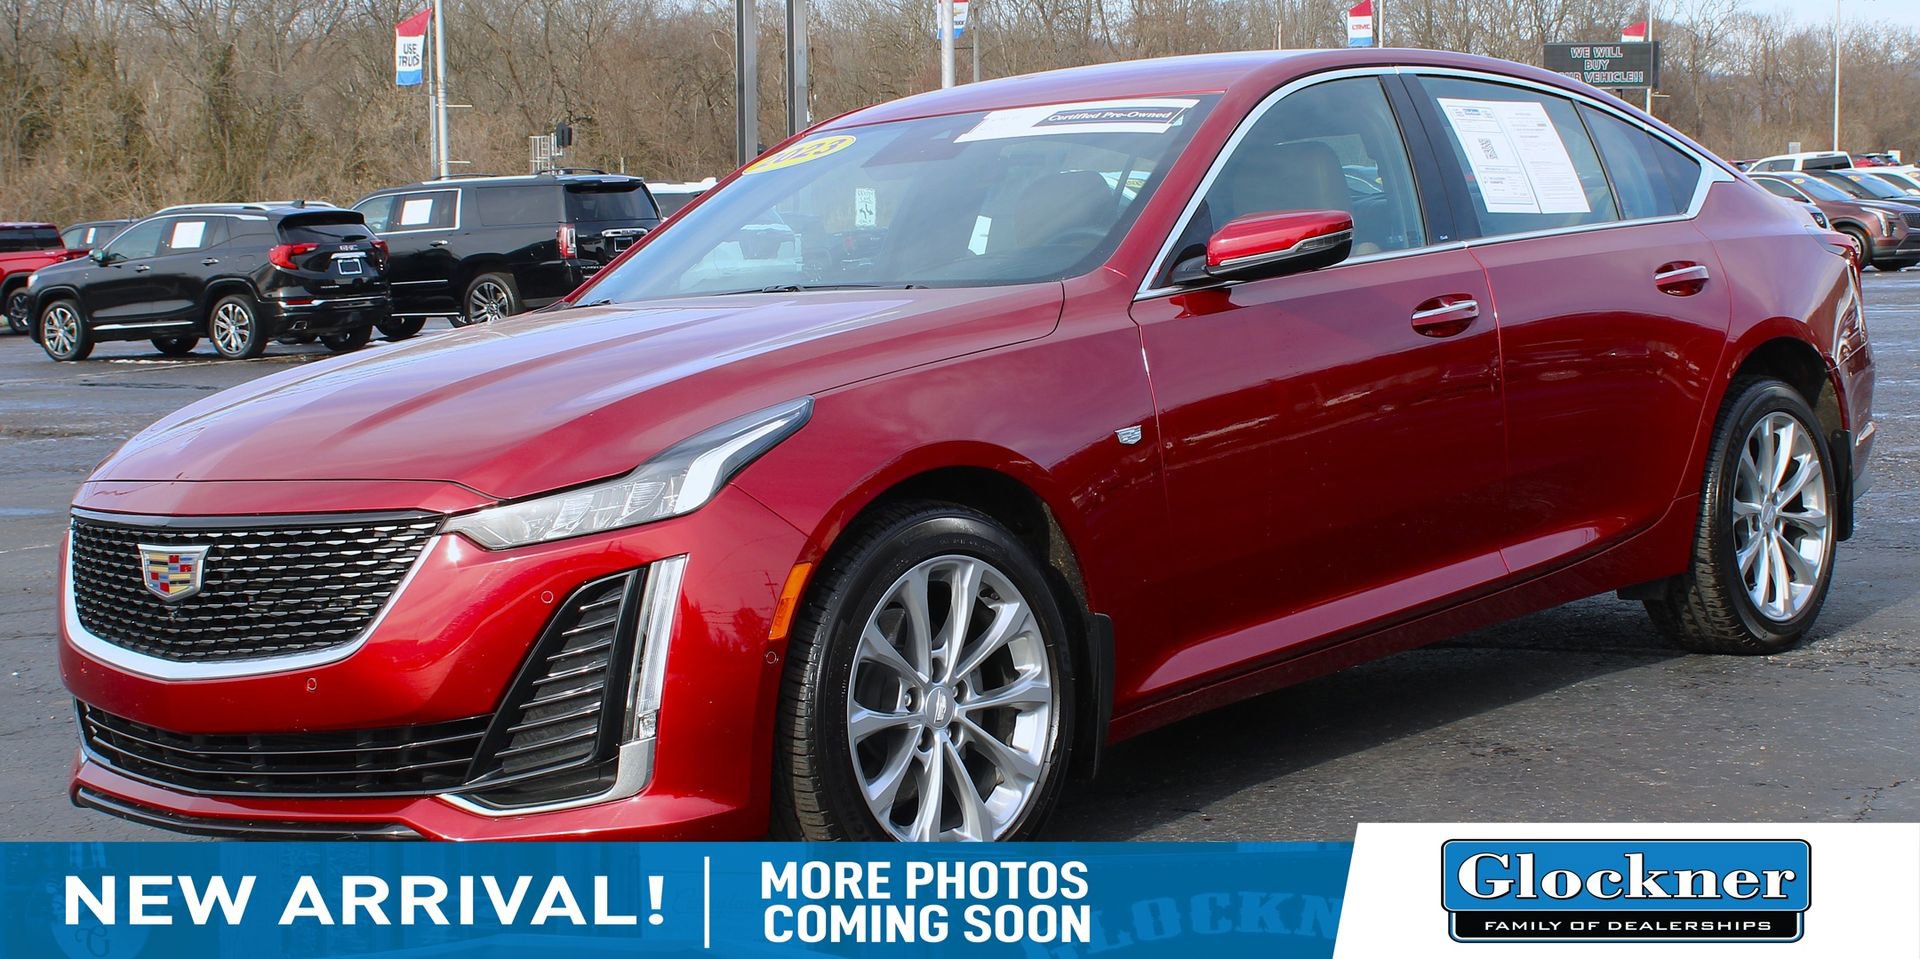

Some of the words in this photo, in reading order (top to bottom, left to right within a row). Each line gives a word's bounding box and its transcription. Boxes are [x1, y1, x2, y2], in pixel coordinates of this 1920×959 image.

[1351, 23, 1371, 31] GMC
[1570, 46, 1590, 58] WE
[1593, 46, 1624, 58] WILL
[1584, 59, 1610, 71] BUY
[1584, 71, 1644, 83] VEHICLE!!
[1047, 111, 1100, 122] Certified
[1101, 110, 1173, 121] Pre-Owned
